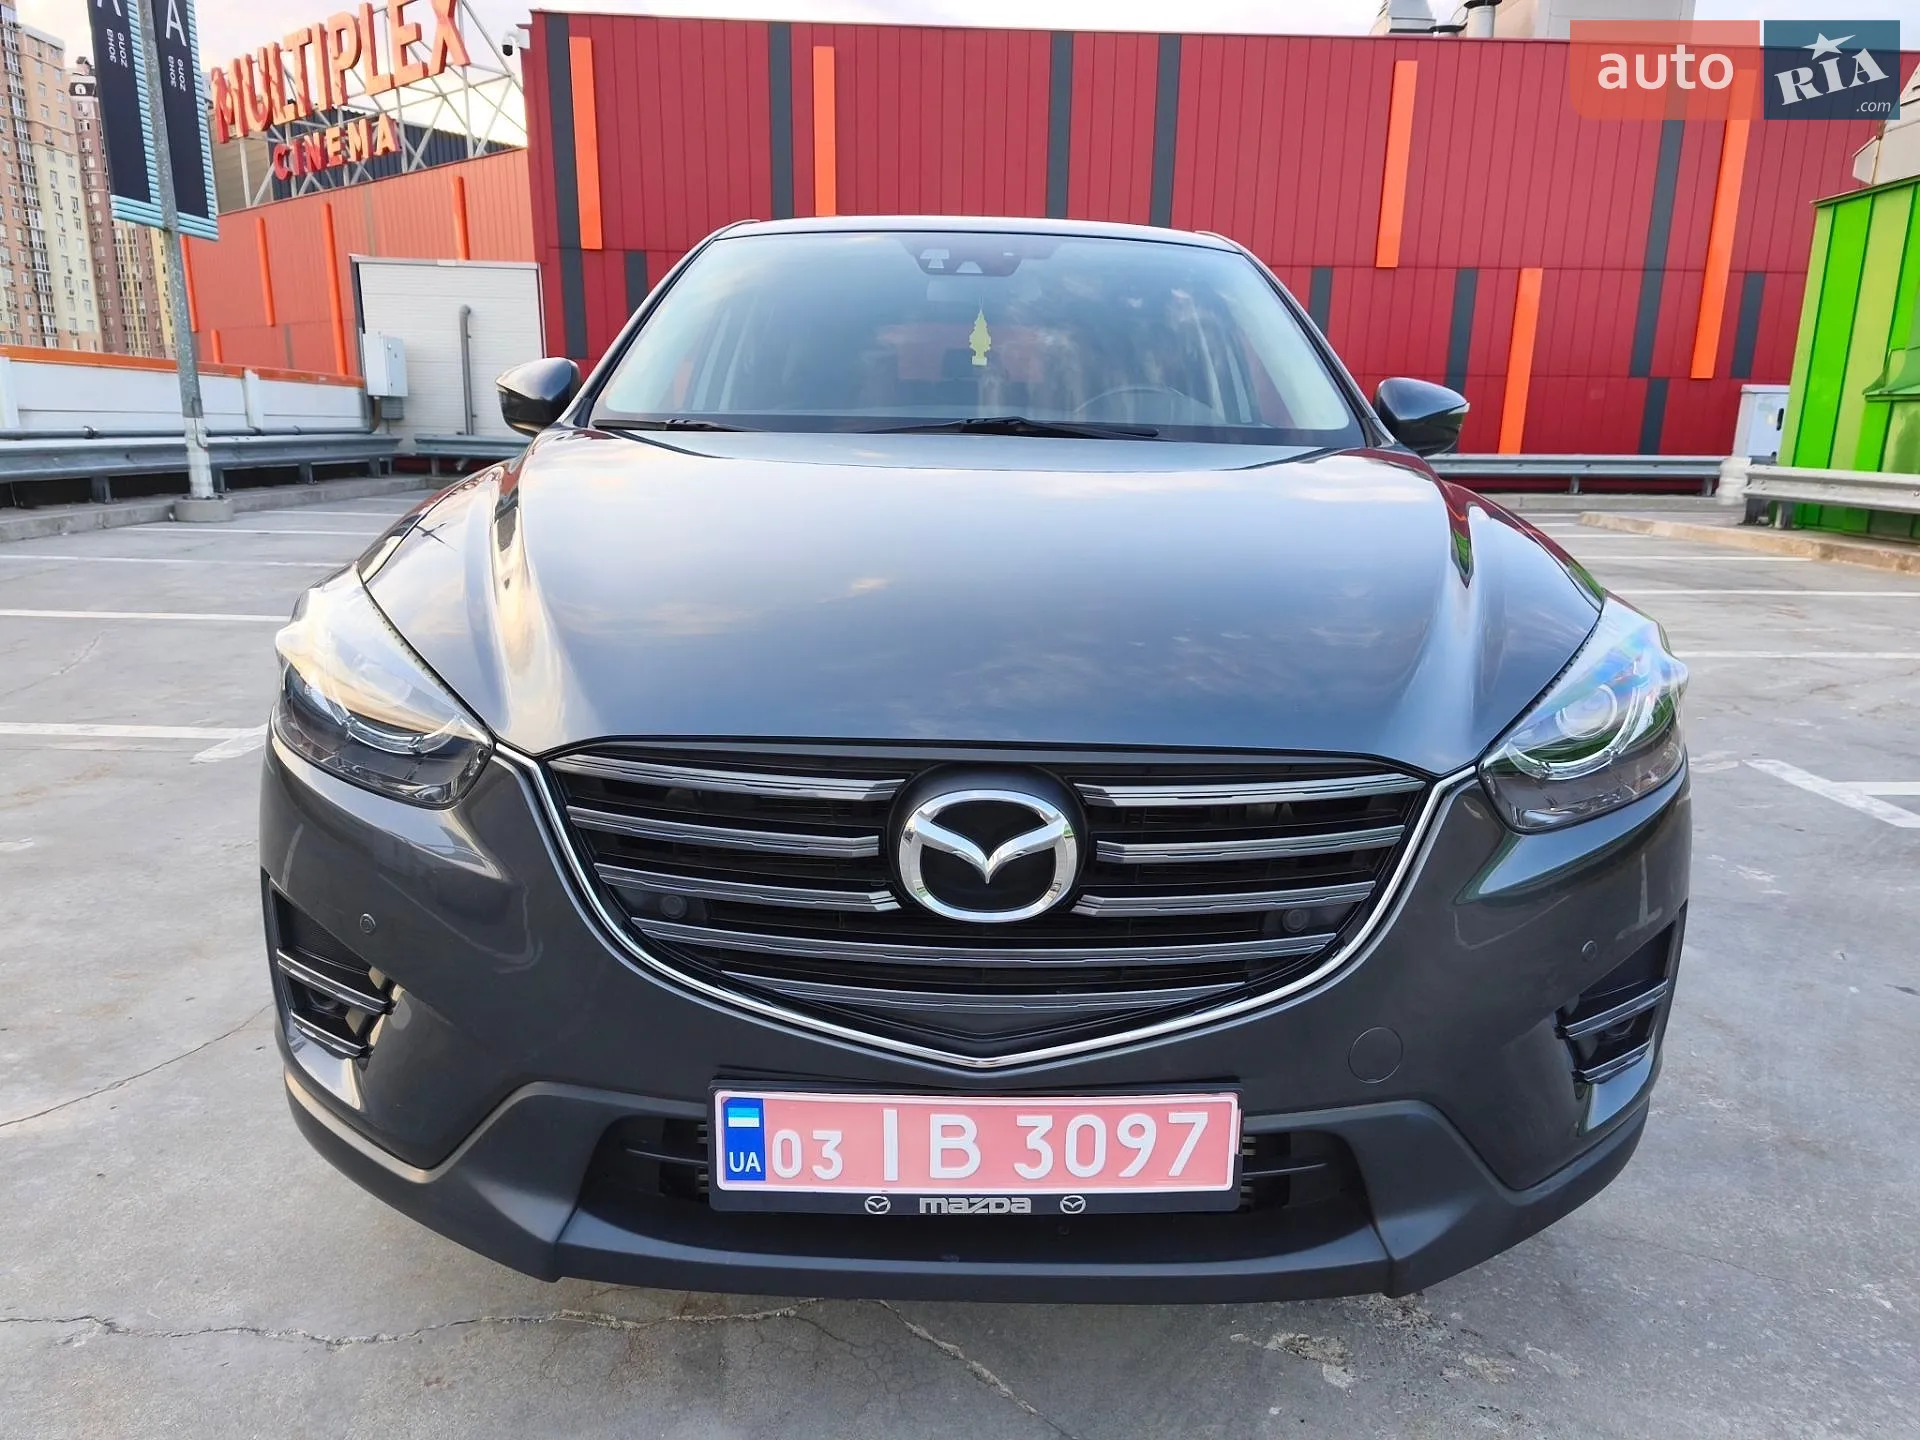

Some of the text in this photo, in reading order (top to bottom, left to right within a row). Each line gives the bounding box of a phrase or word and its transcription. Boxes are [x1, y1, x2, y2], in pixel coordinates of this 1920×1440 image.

[117, 32, 128, 68] zone
[211, 0, 471, 144] MULTIPLEX
[273, 113, 402, 181] CINEMA
[728, 1151, 762, 1174] UA
[772, 1128, 843, 1180] 03
[1013, 1111, 1209, 1180] 3097
